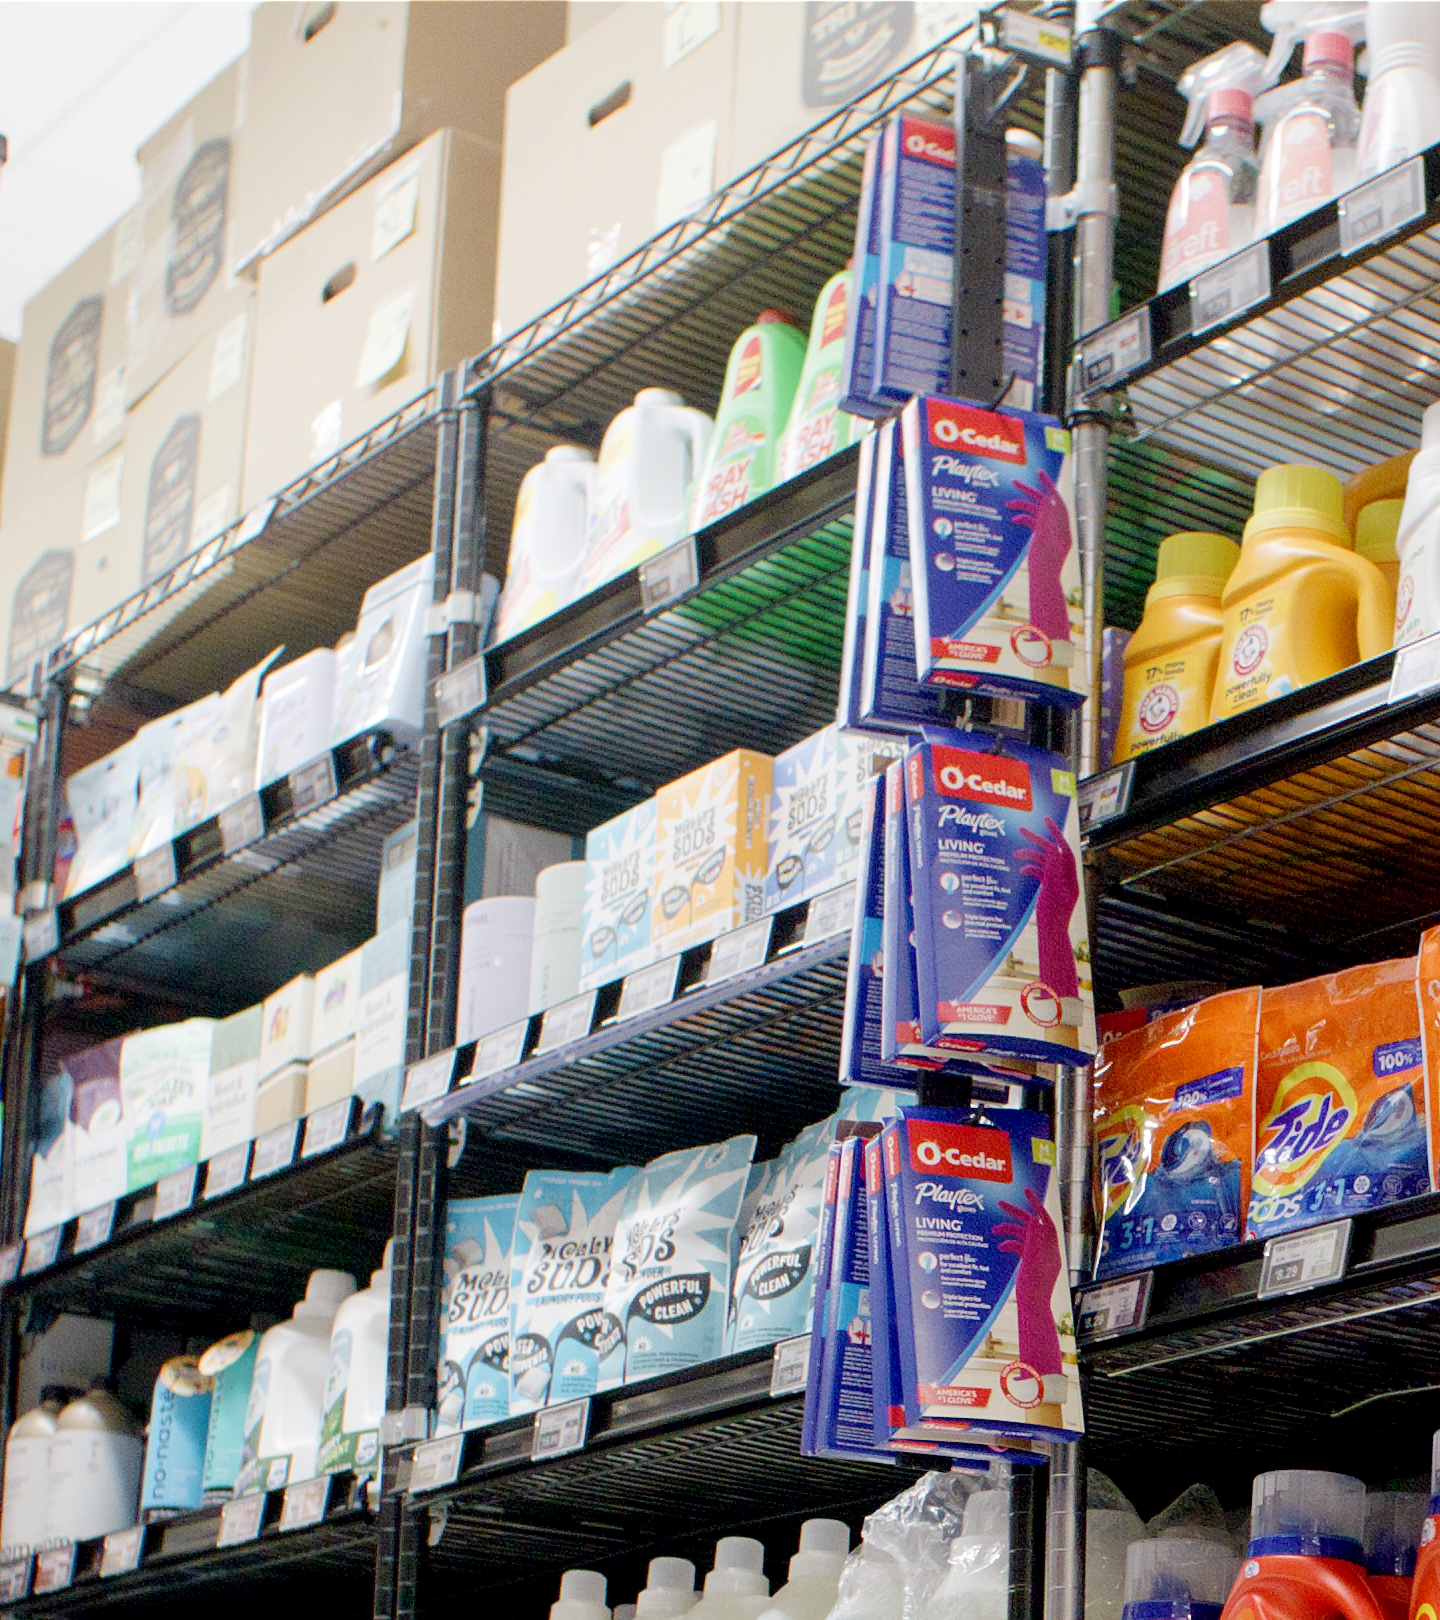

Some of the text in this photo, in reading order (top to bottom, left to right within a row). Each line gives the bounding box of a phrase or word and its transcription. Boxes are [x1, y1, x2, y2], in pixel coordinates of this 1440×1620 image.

[1164, 219, 1221, 264] dreft
[932, 455, 999, 487] Playtex
[932, 486, 977, 502] LIVING
[1225, 671, 1273, 700] powerfully
[1233, 686, 1259, 704] clean
[787, 790, 828, 831] SUDS
[938, 804, 1006, 836] Playtex
[672, 824, 716, 862] SUDS
[938, 839, 985, 854] LIVING
[956, 1005, 998, 1016] AMERICA'S
[1378, 1050, 1415, 1072] 100%
[1255, 1093, 1351, 1170] Tide
[1038, 1144, 1051, 1155] M
[915, 1182, 985, 1211] Playtex
[916, 1216, 962, 1231] LIVING
[637, 1279, 703, 1309] POWERFUL
[758, 1273, 791, 1297] CLEAN
[653, 1301, 693, 1321] CLEAN
[936, 1388, 977, 1399] AMERICA'S
